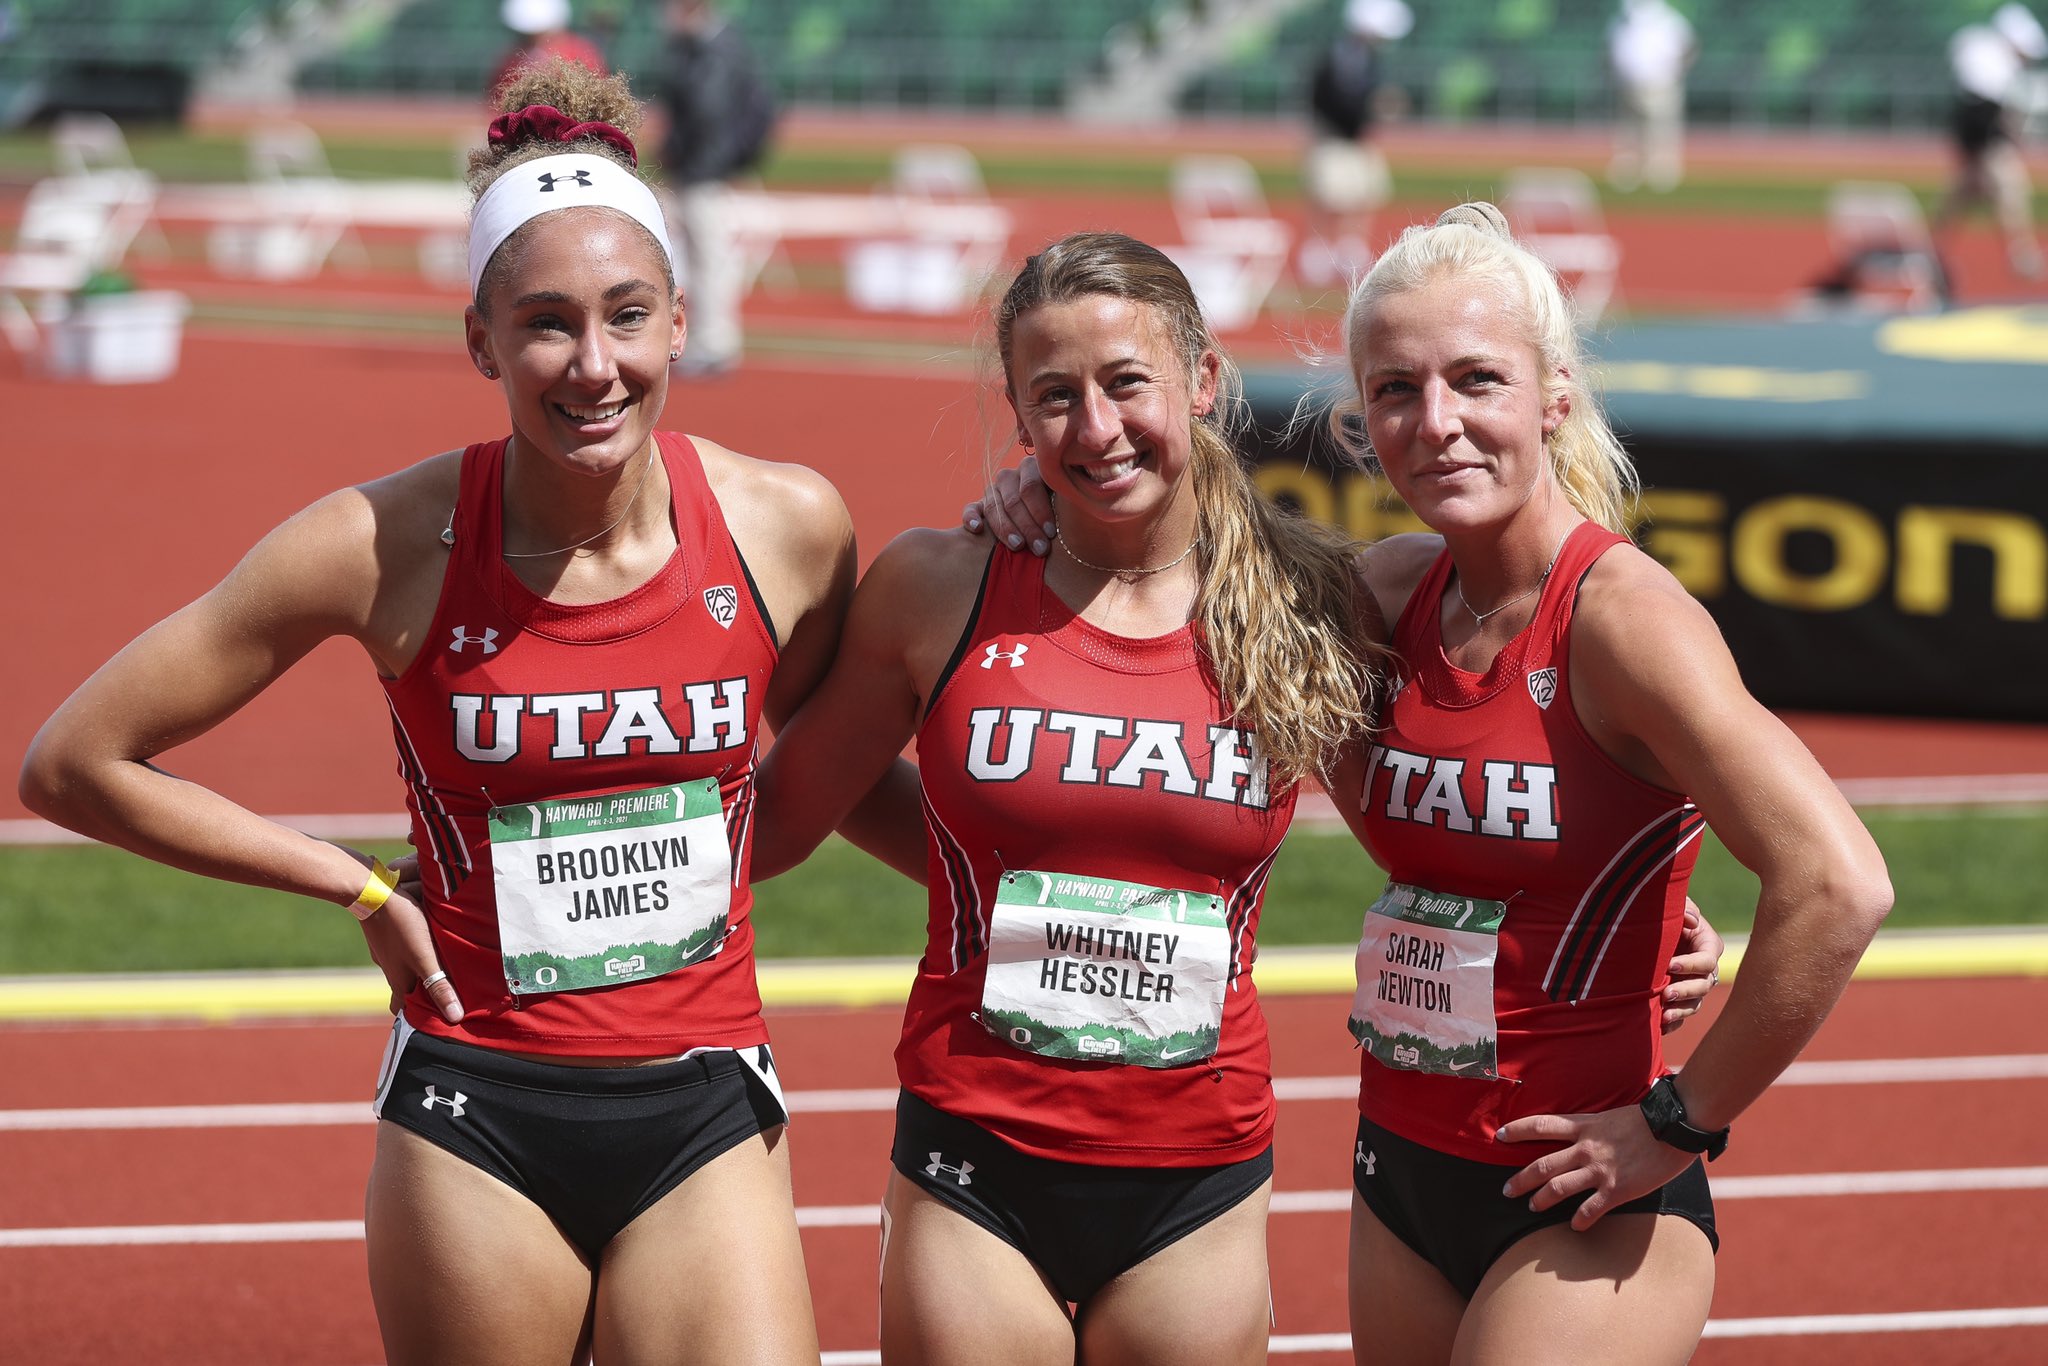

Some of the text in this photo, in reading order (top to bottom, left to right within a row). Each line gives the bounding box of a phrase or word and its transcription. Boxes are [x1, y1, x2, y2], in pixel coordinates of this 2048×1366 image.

[1252, 460, 2047, 622] OGON
[705, 587, 736, 613] PAC
[716, 605, 734, 622] 12
[1530, 669, 1556, 695] PAC
[1537, 686, 1553, 703] 12
[449, 675, 749, 763] UTAH
[964, 707, 1269, 812] UTAH
[545, 792, 670, 823] HAYWARD PREMIERE
[587, 819, 602, 827] APRIL
[536, 835, 689, 885] BROOKLYN
[566, 880, 669, 922] JAMES
[1055, 880, 1115, 900] HAYWARD
[1045, 922, 1179, 965] WHITNEY
[1386, 932, 1445, 972] SARAH
[1039, 958, 1174, 1003] HESSLER
[1377, 970, 1452, 1014] NEWTON
